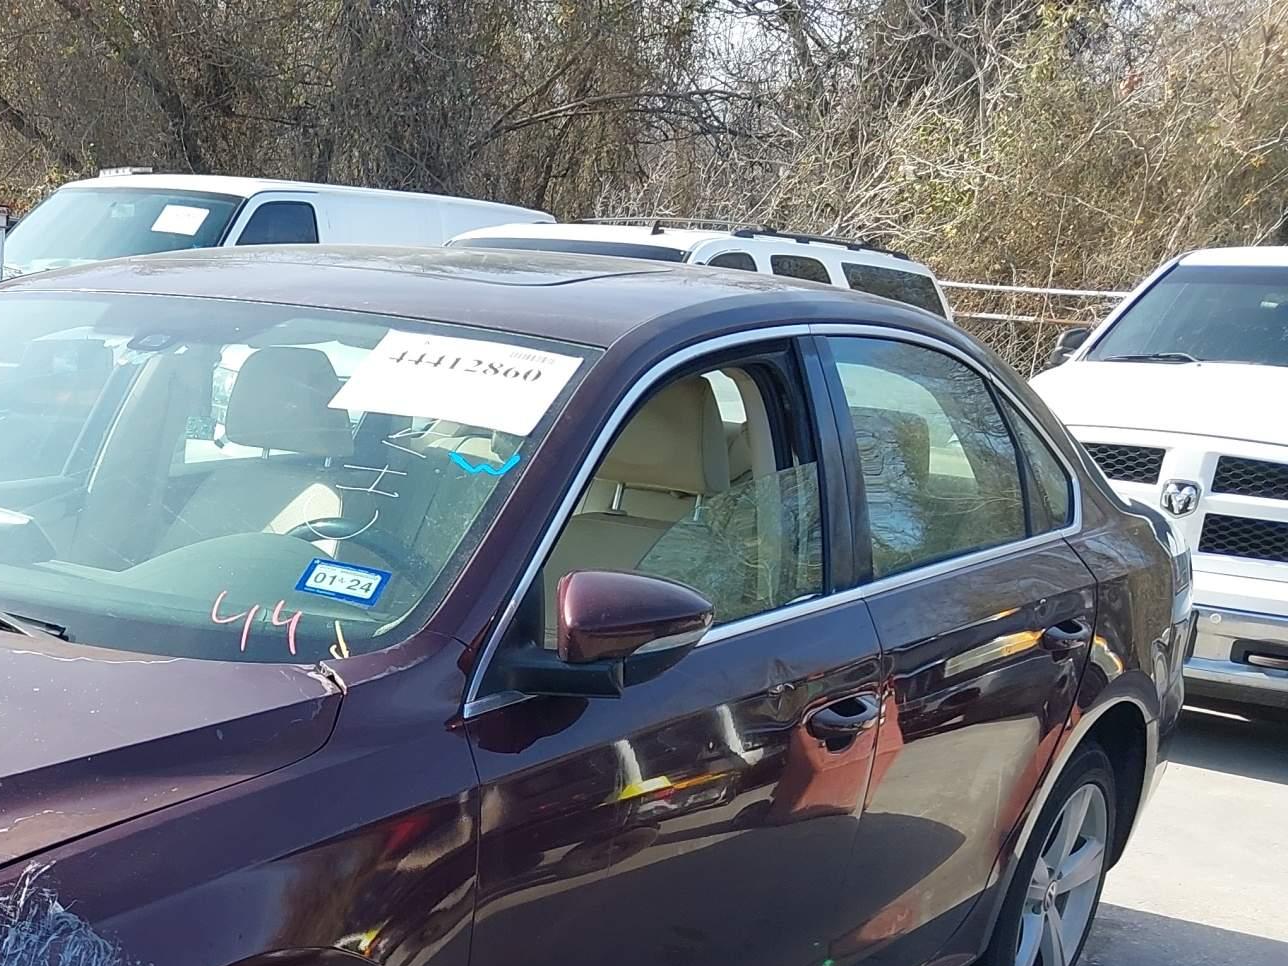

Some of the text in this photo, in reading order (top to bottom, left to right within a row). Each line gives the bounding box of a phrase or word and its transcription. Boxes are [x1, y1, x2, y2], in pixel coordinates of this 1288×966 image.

[389, 350, 542, 383] 44412860
[313, 572, 338, 586] 01
[345, 578, 374, 593] 24
